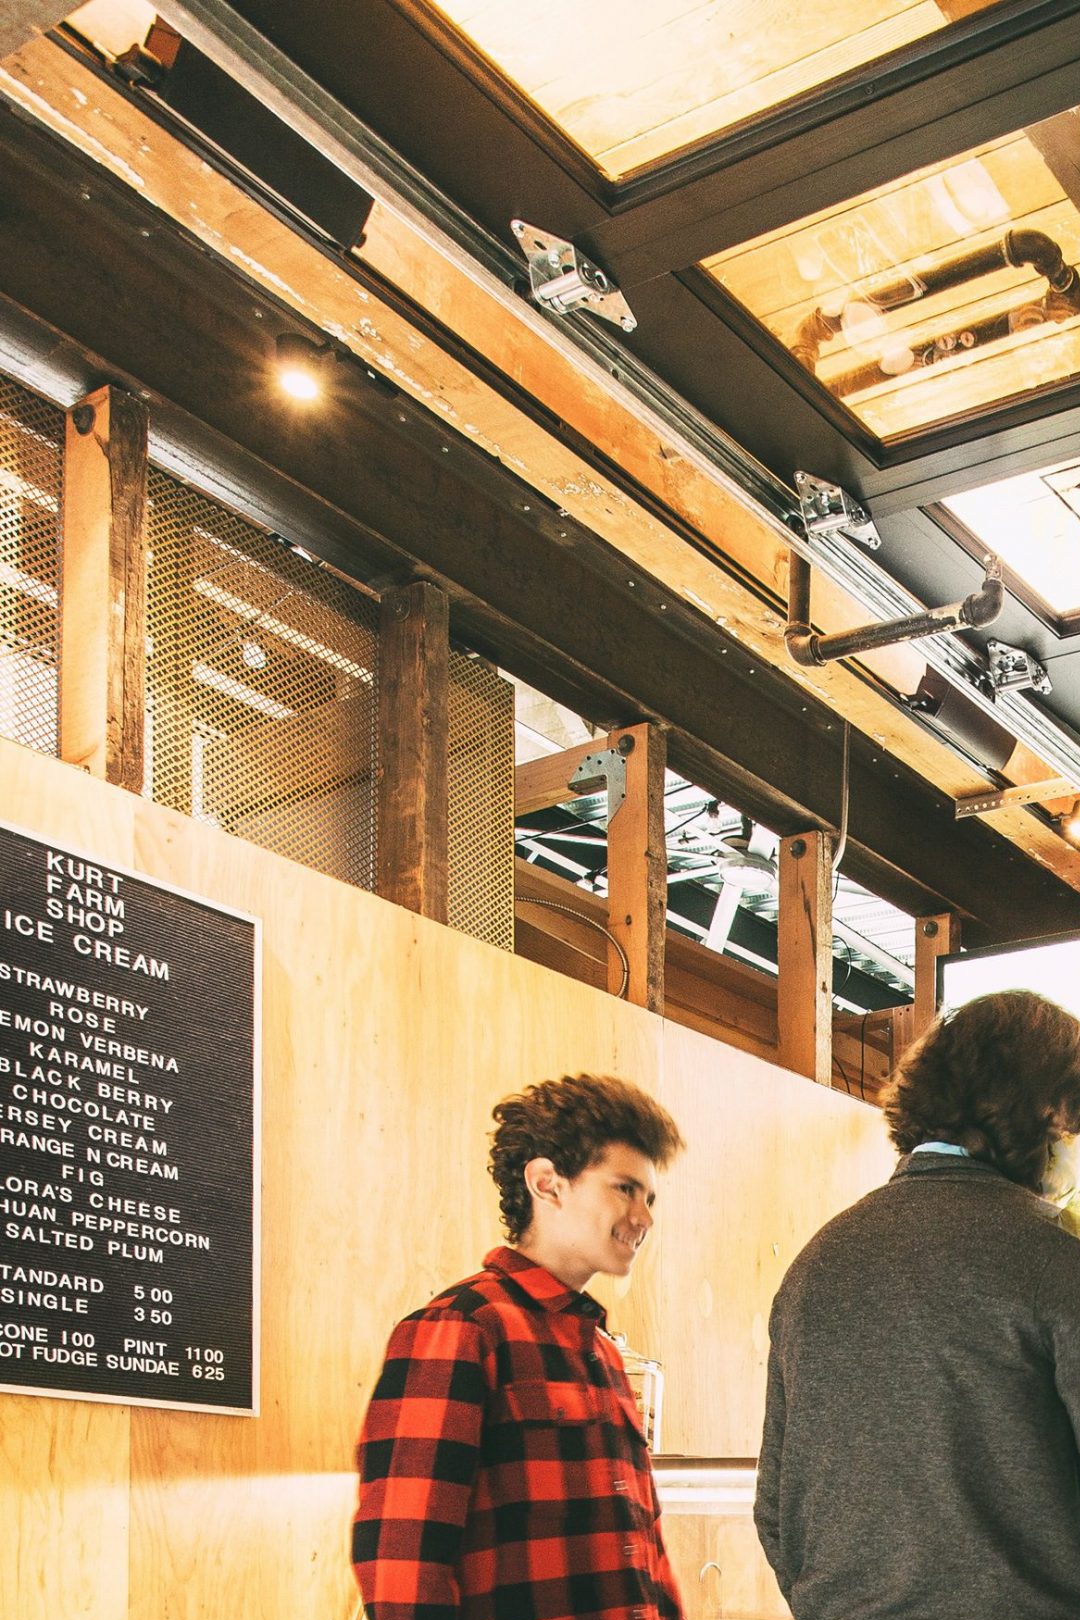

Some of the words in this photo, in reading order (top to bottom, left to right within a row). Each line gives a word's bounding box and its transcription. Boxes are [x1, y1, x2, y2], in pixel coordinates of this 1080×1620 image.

[47, 851, 124, 894] KURT
[47, 874, 125, 918] FARM
[46, 898, 124, 938] SHOP
[5, 910, 54, 943] ICE
[73, 934, 170, 980] CREAM
[0, 963, 149, 1020] STRAWBERRY
[50, 1001, 116, 1034] ROSE
[30, 1041, 139, 1085] KARAMEL
[80, 1032, 179, 1074] VERBENA
[0, 1057, 81, 1091] BLACK
[98, 1083, 173, 1114] BERRY
[12, 1084, 155, 1131] CHOCOLATE
[88, 1125, 167, 1156] CREAM
[62, 1164, 104, 1187] FIG
[106, 1152, 179, 1180] CREAM
[89, 1192, 181, 1224] CHEESE
[5, 1222, 94, 1251] SALTED
[108, 1240, 164, 1264] PLUM
[71, 1211, 210, 1250] PEPPERCORN
[0, 1288, 89, 1314] SINGLE
[0, 1323, 48, 1343] ONE
[124, 1338, 167, 1357] PINT
[33, 1346, 98, 1367] FUDGE
[106, 1355, 180, 1377] SUNDAE
